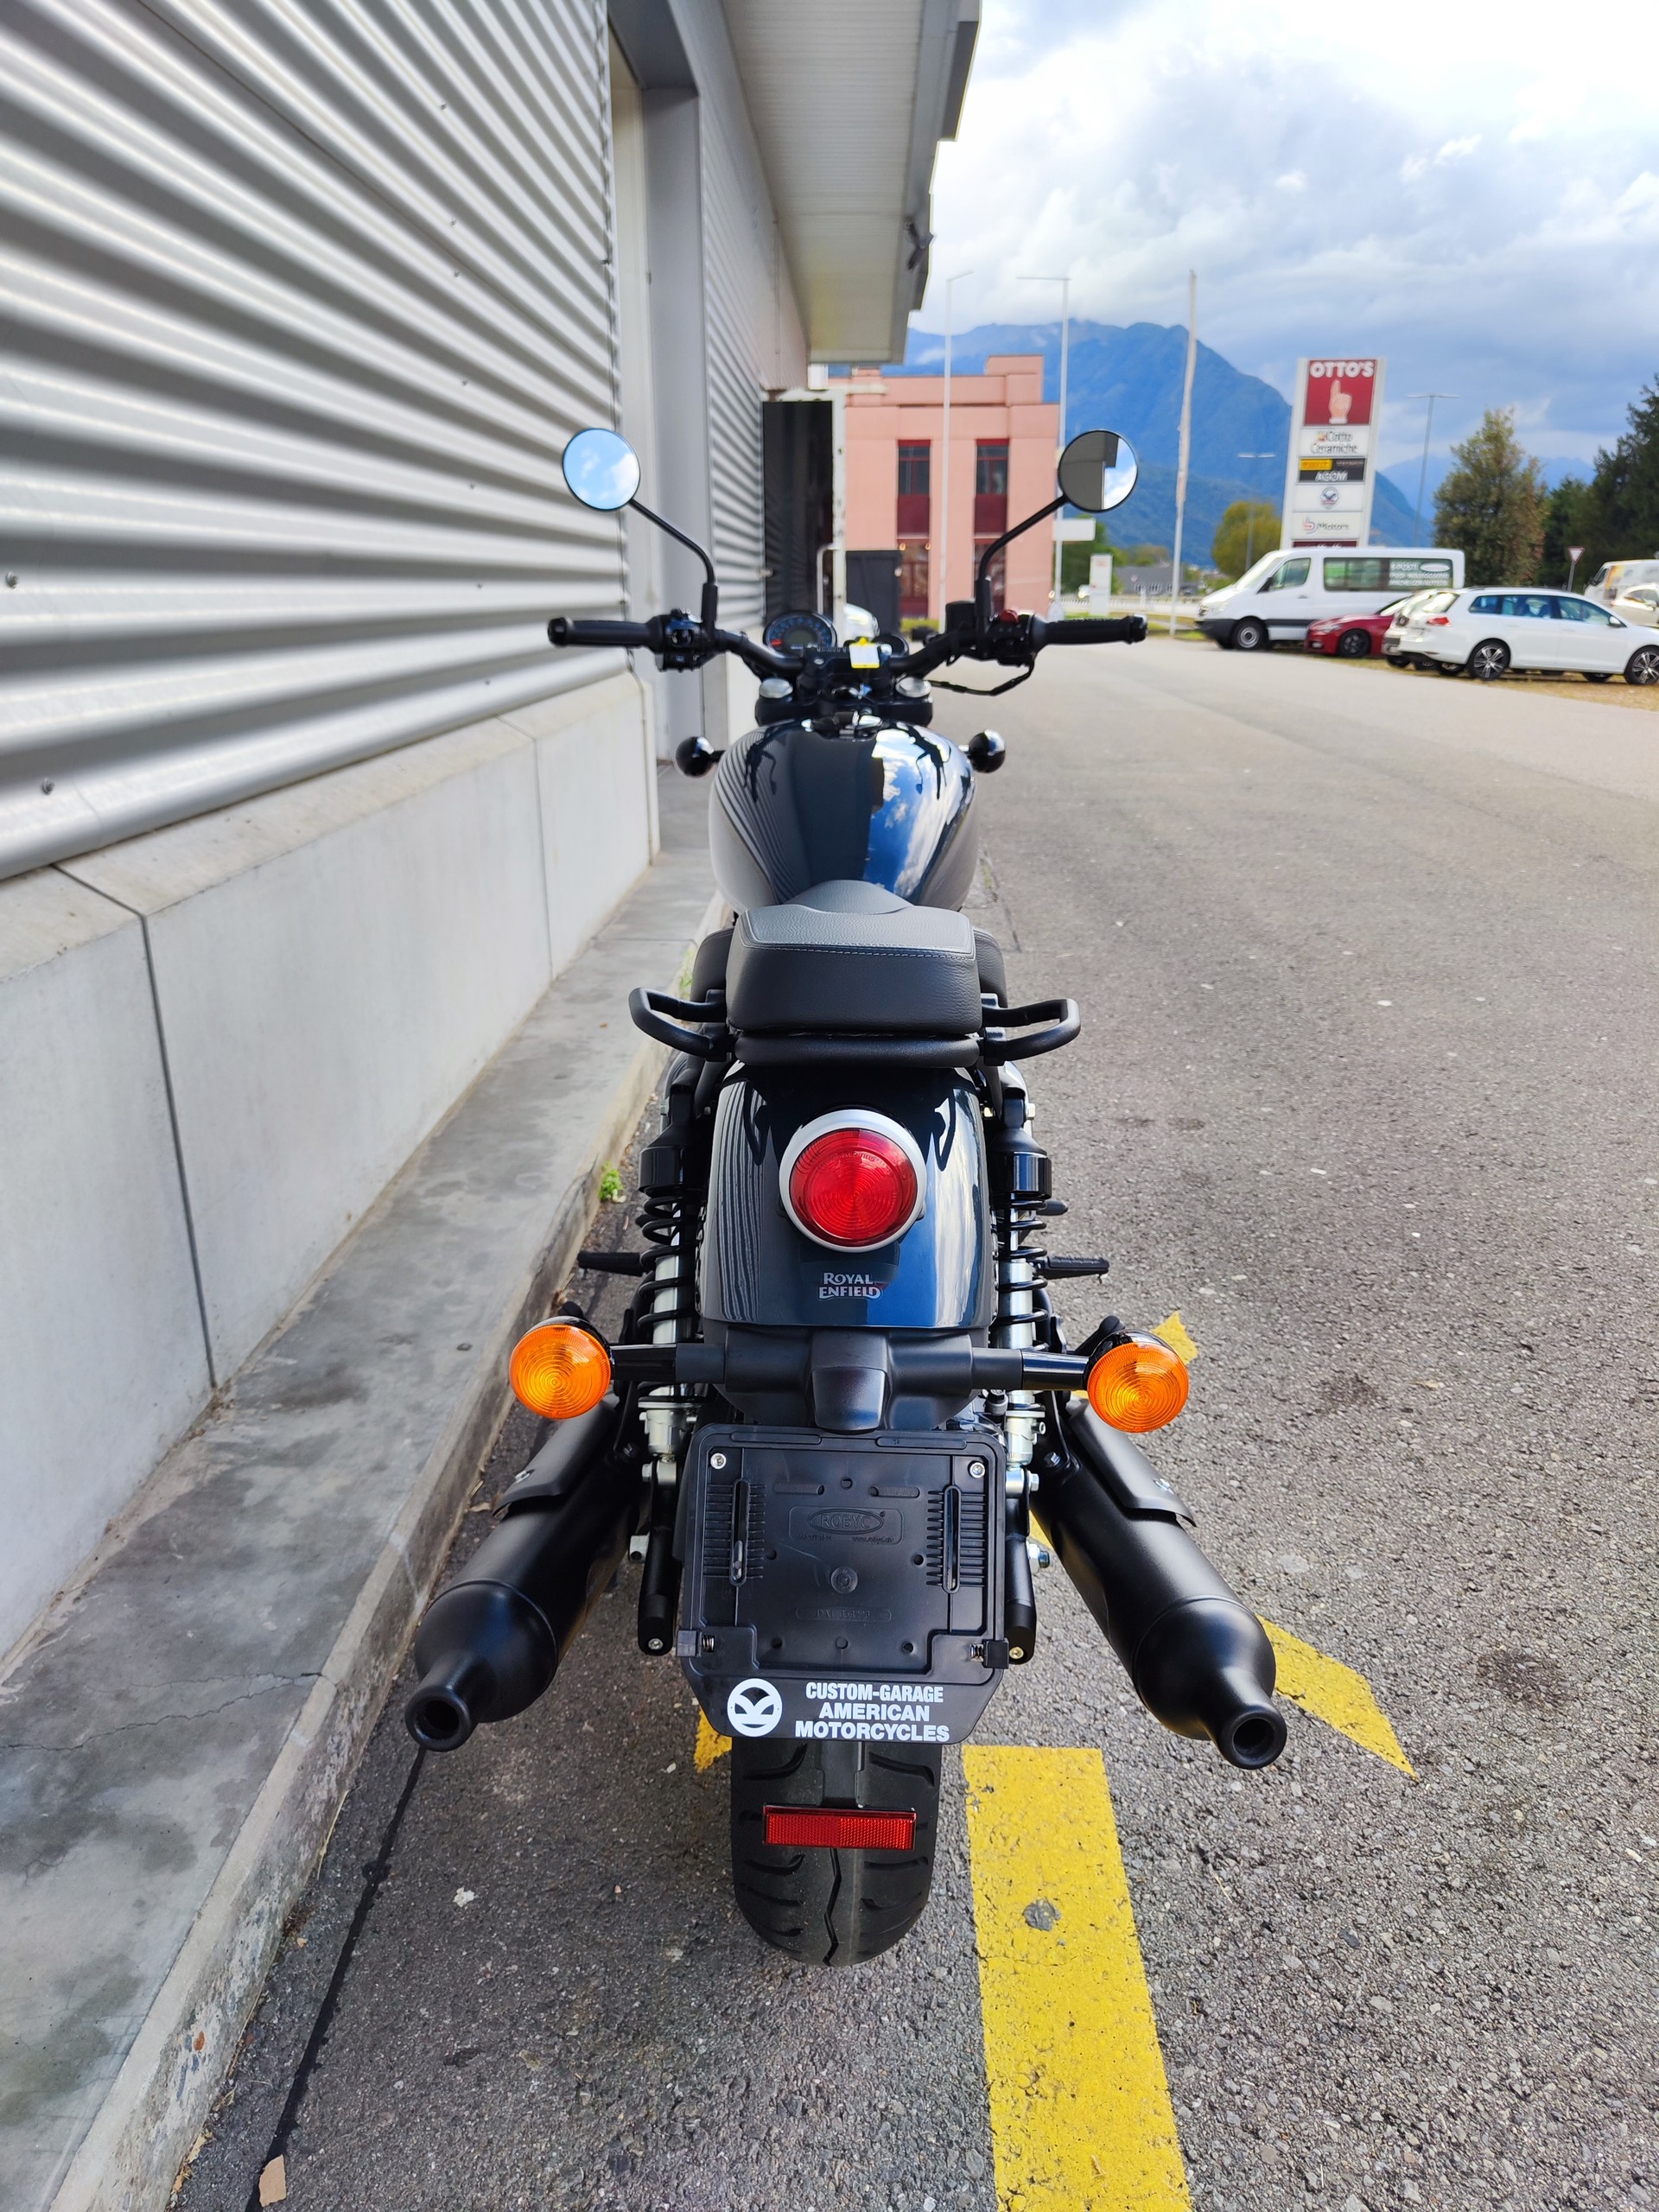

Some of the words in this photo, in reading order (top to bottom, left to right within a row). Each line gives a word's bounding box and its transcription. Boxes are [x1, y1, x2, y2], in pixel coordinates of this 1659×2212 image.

[1309, 360, 1375, 378] OTTO'S
[823, 1272, 874, 1286] ROYAL
[818, 1286, 881, 1300] ENFIELD
[820, 1515, 871, 1529] ROBYC
[805, 1681, 944, 1703] CUSTOM-GARAGE
[819, 1702, 930, 1722] AMERICAN
[795, 1720, 950, 1742] MOTORCYCLES
